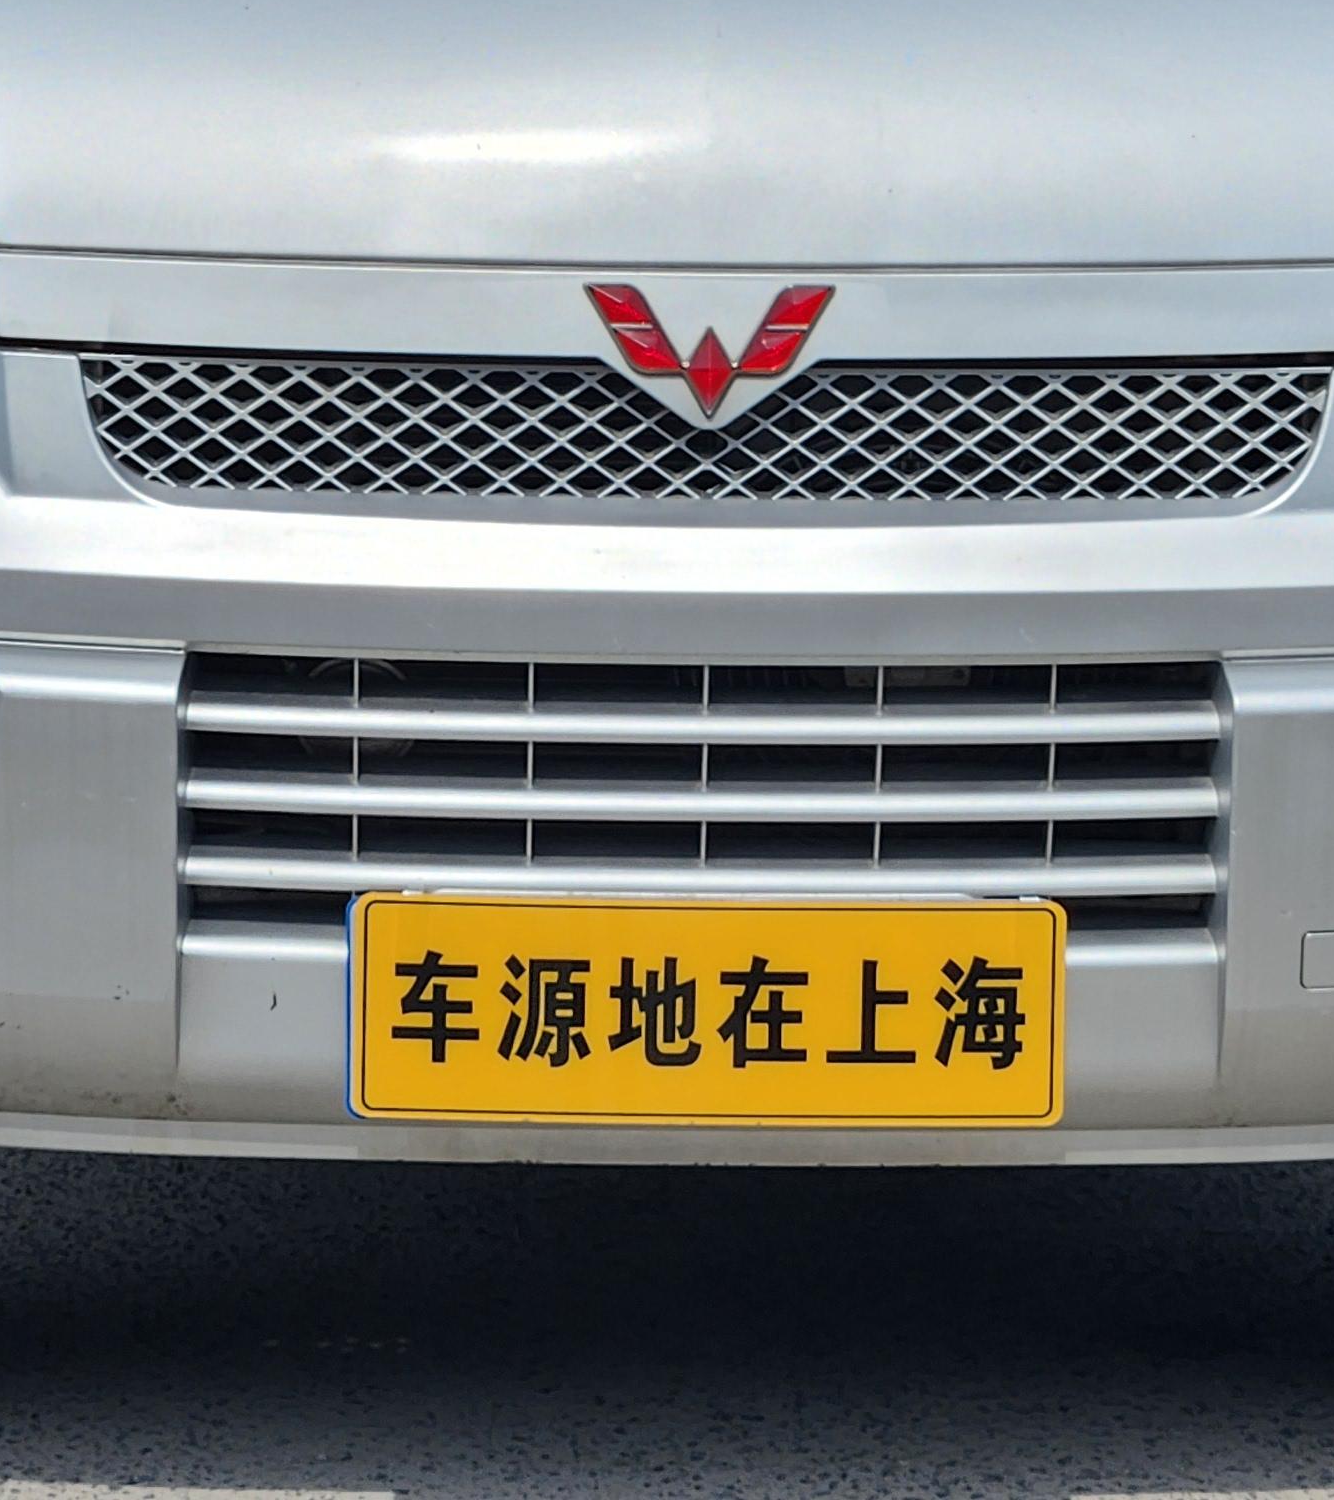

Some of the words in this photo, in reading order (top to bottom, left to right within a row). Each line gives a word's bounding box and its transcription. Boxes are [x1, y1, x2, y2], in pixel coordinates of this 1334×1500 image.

[391, 949, 1026, 1070] 车源地在上海
